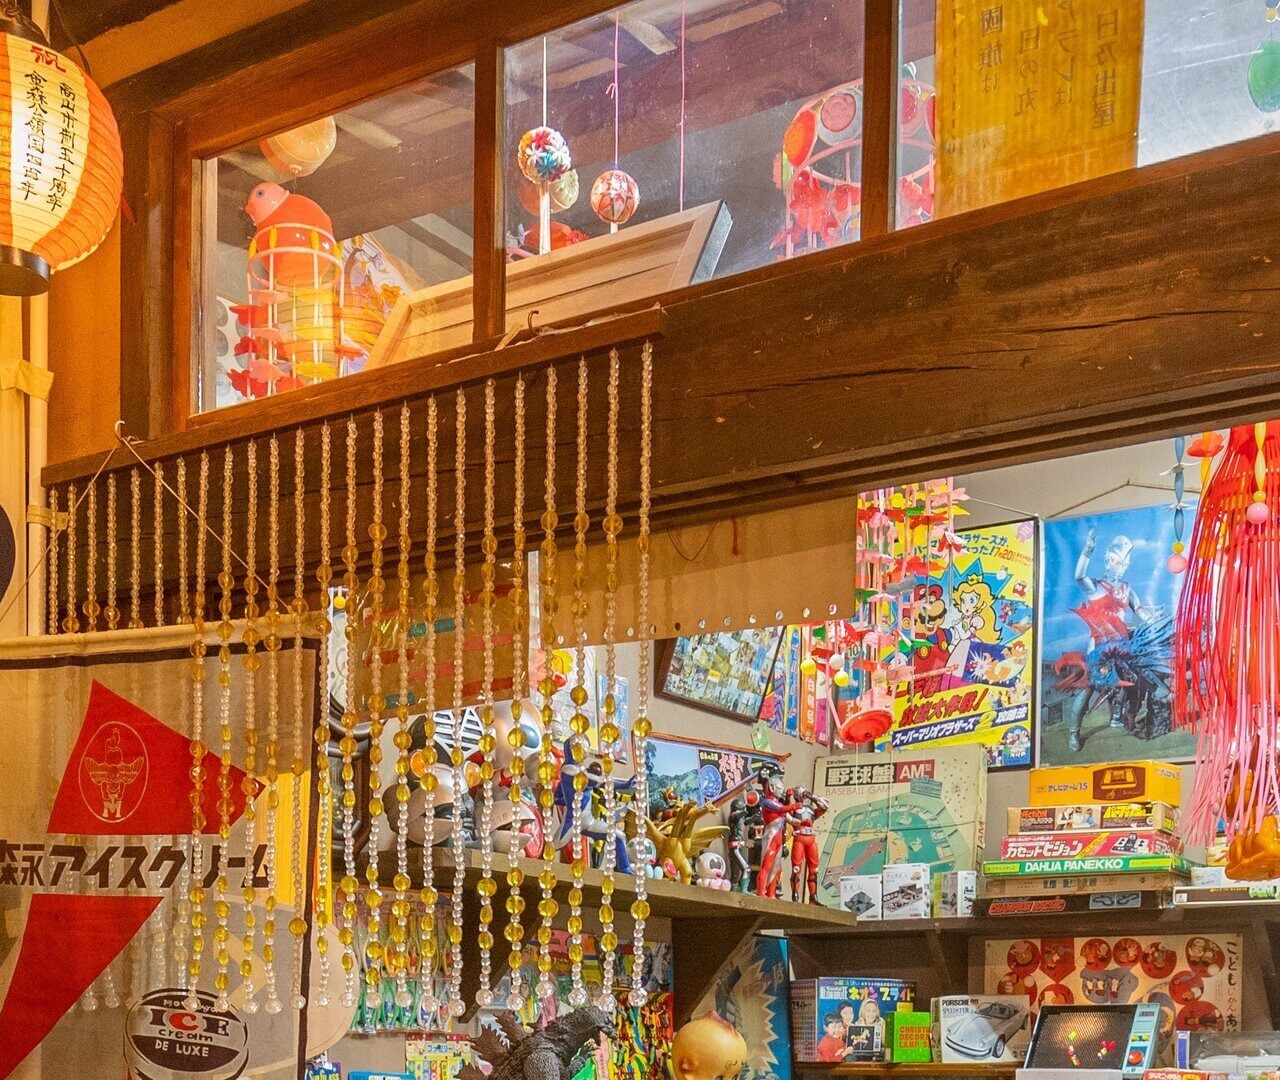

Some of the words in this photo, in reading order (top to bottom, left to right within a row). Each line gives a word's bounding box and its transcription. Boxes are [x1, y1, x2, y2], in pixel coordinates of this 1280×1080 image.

[30, 45, 66, 73] 祝
[827, 764, 895, 786] 野球盤
[1079, 781, 1088, 791] 15
[1005, 840, 1084, 859] カセットビジョン
[1024, 861, 1062, 873] DAHLIA
[1063, 859, 1124, 872] PANEKKO
[942, 999, 970, 1007] PORSCHE
[149, 1008, 230, 1037] ICE
[158, 1028, 213, 1042] cream
[155, 1040, 169, 1051] DE
[175, 1043, 209, 1057] LUXE
